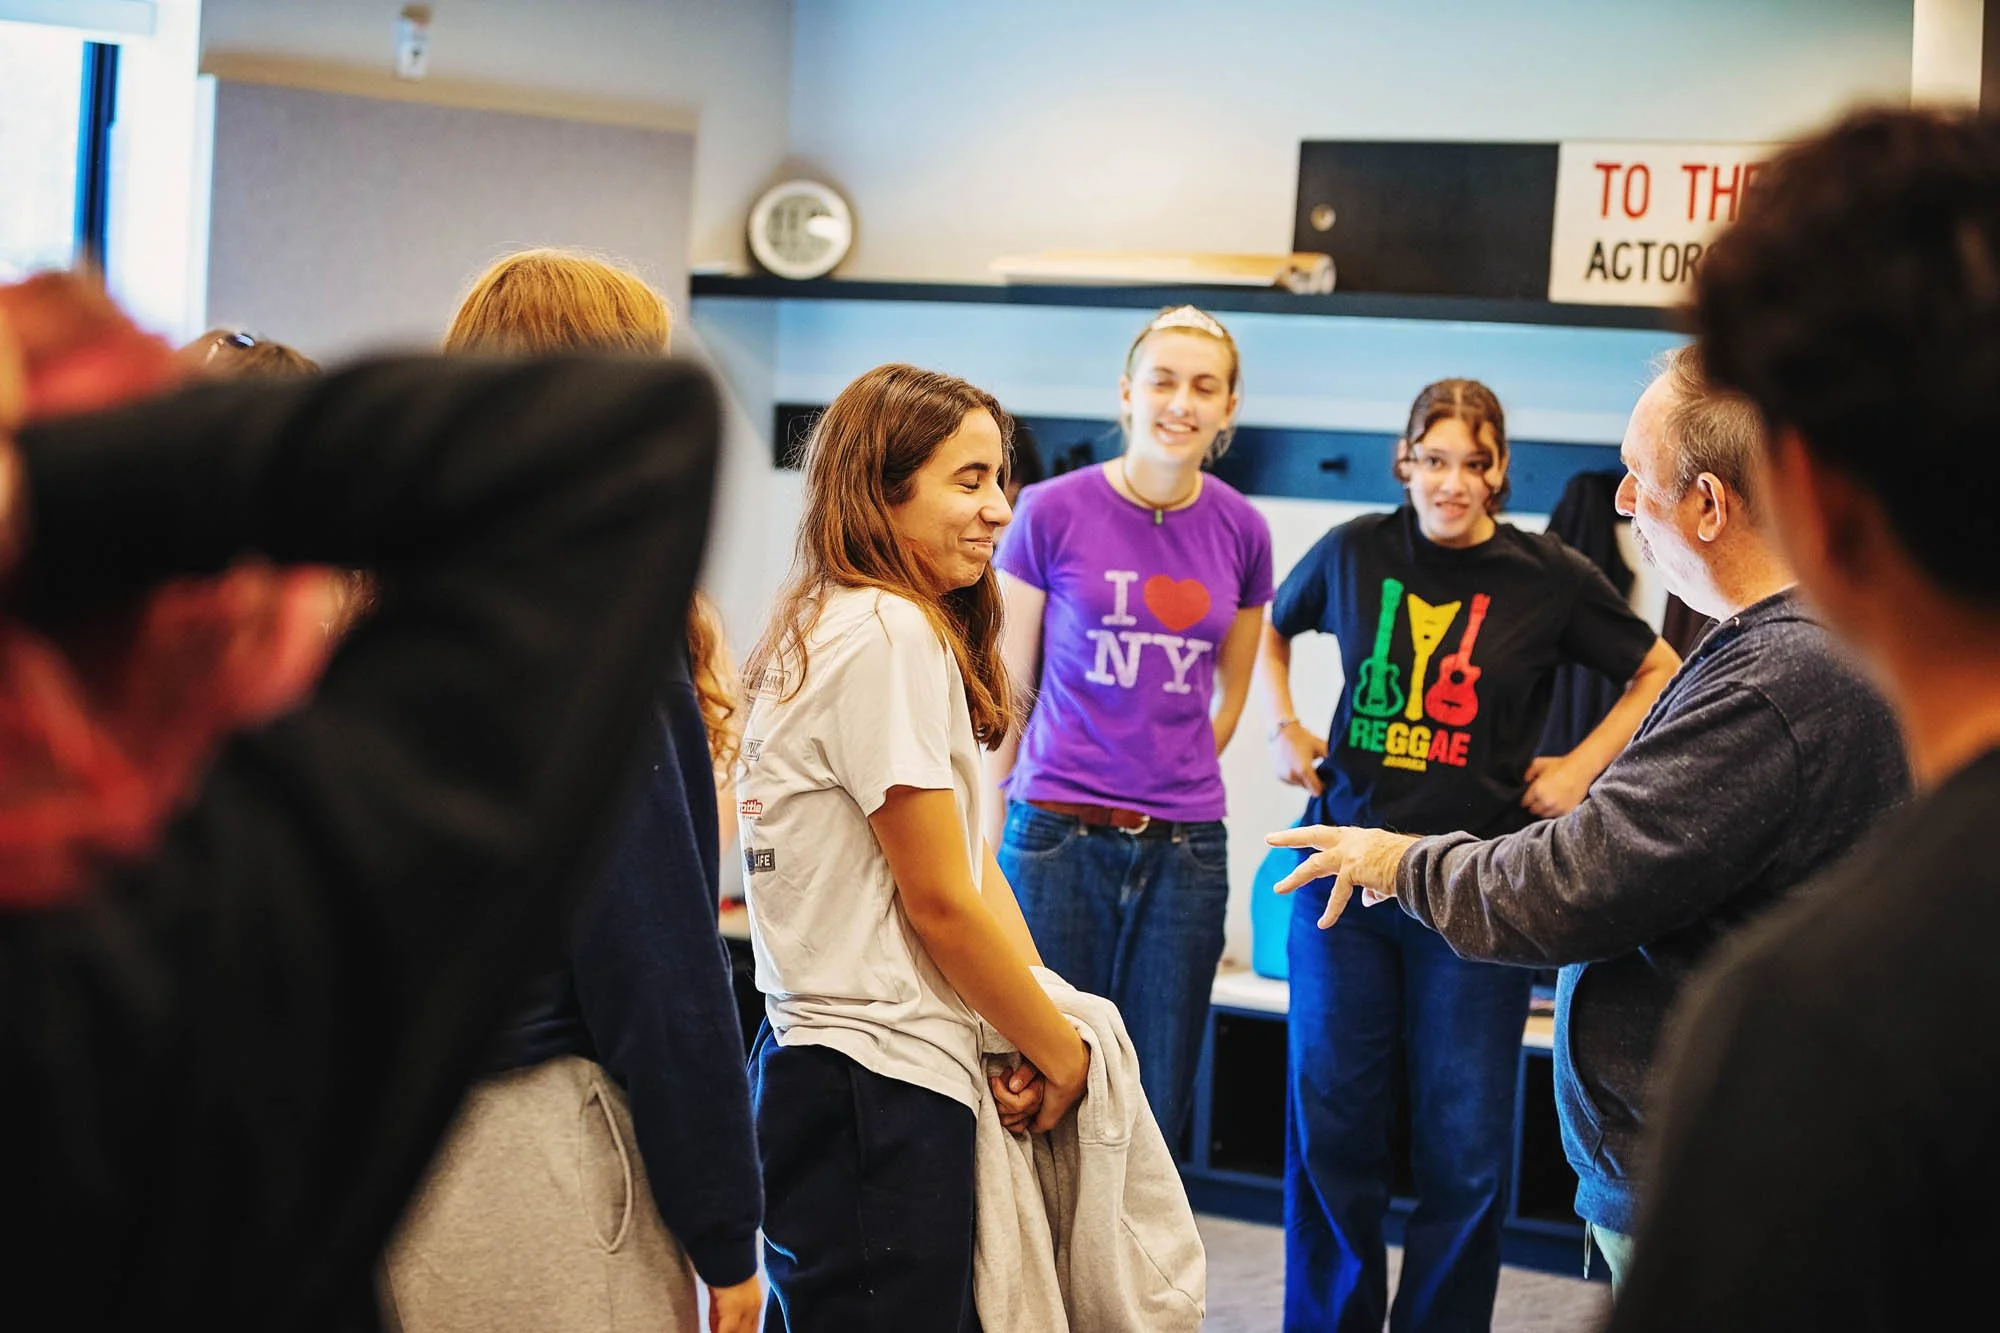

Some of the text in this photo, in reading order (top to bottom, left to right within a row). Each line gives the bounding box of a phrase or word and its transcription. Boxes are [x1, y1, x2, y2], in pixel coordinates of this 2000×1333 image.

[1594, 162, 1651, 220] TO
[1585, 240, 1717, 283] ACTOR
[1102, 570, 1138, 626] I
[1085, 628, 1213, 694] NY
[1348, 717, 1471, 767] REGGAE
